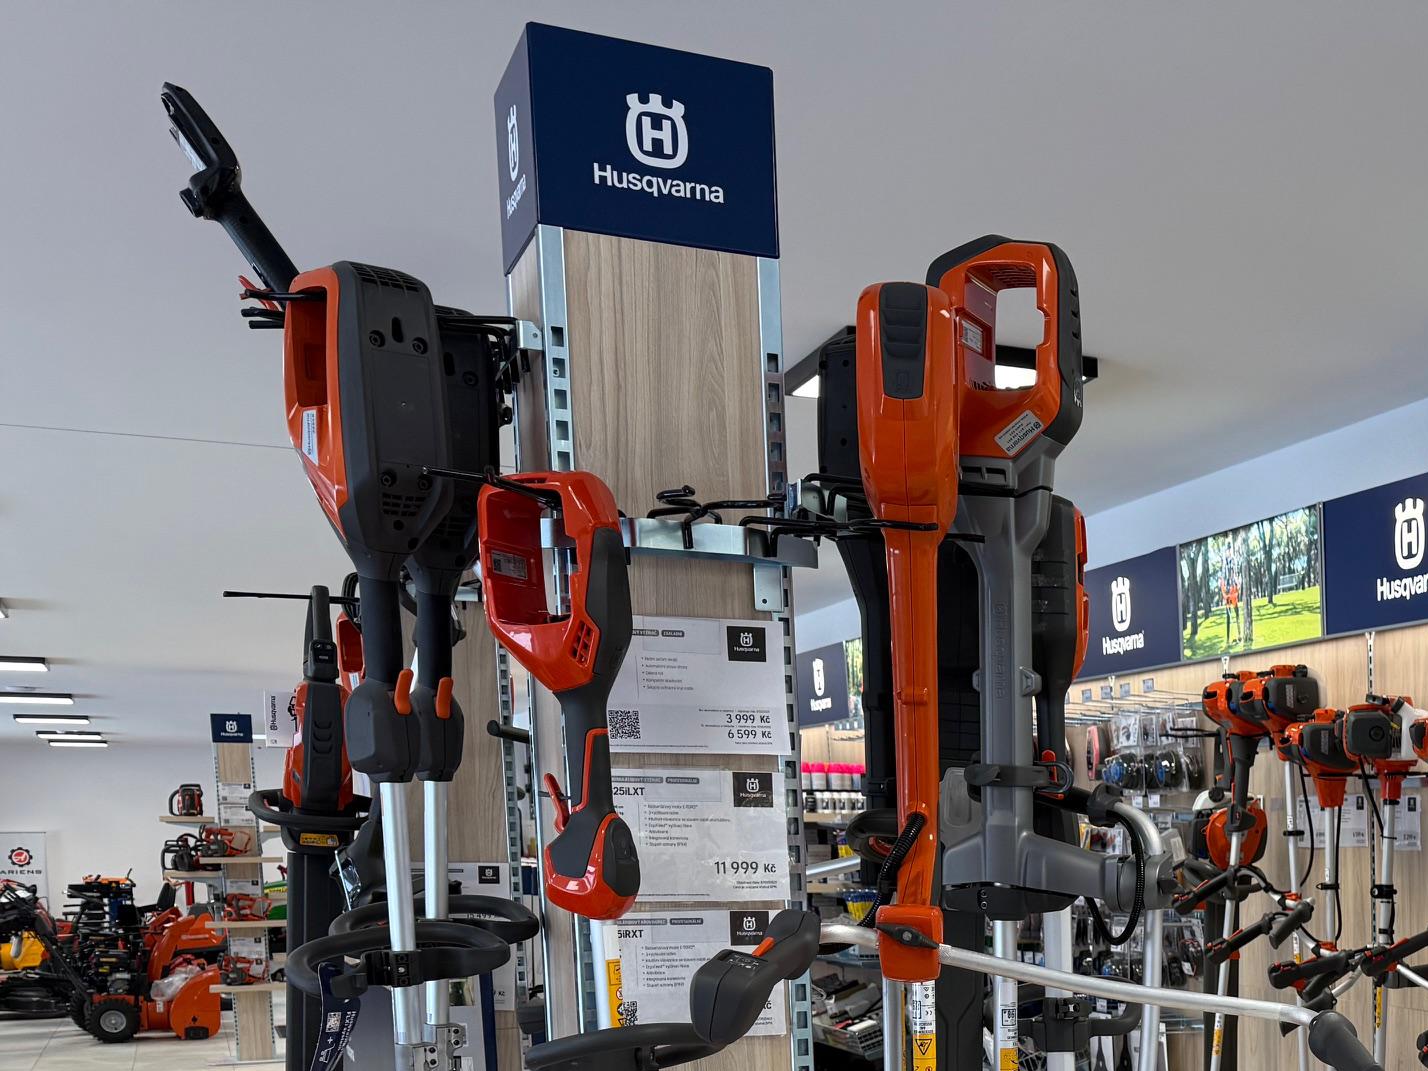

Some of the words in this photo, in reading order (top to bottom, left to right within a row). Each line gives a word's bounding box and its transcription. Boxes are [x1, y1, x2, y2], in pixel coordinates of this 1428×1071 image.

[593, 162, 725, 204] Husqvarna
[1102, 632, 1145, 656] Husqvarna
[726, 713, 733, 724] 3
[735, 714, 755, 724] 999
[760, 715, 771, 724] Kč
[728, 729, 735, 739] 6
[737, 729, 757, 739] 599
[761, 730, 772, 739] Kč
[611, 786, 645, 796] 25iLXT
[714, 861, 726, 875] 11
[731, 861, 759, 874] 999
[764, 863, 777, 874] Kč
